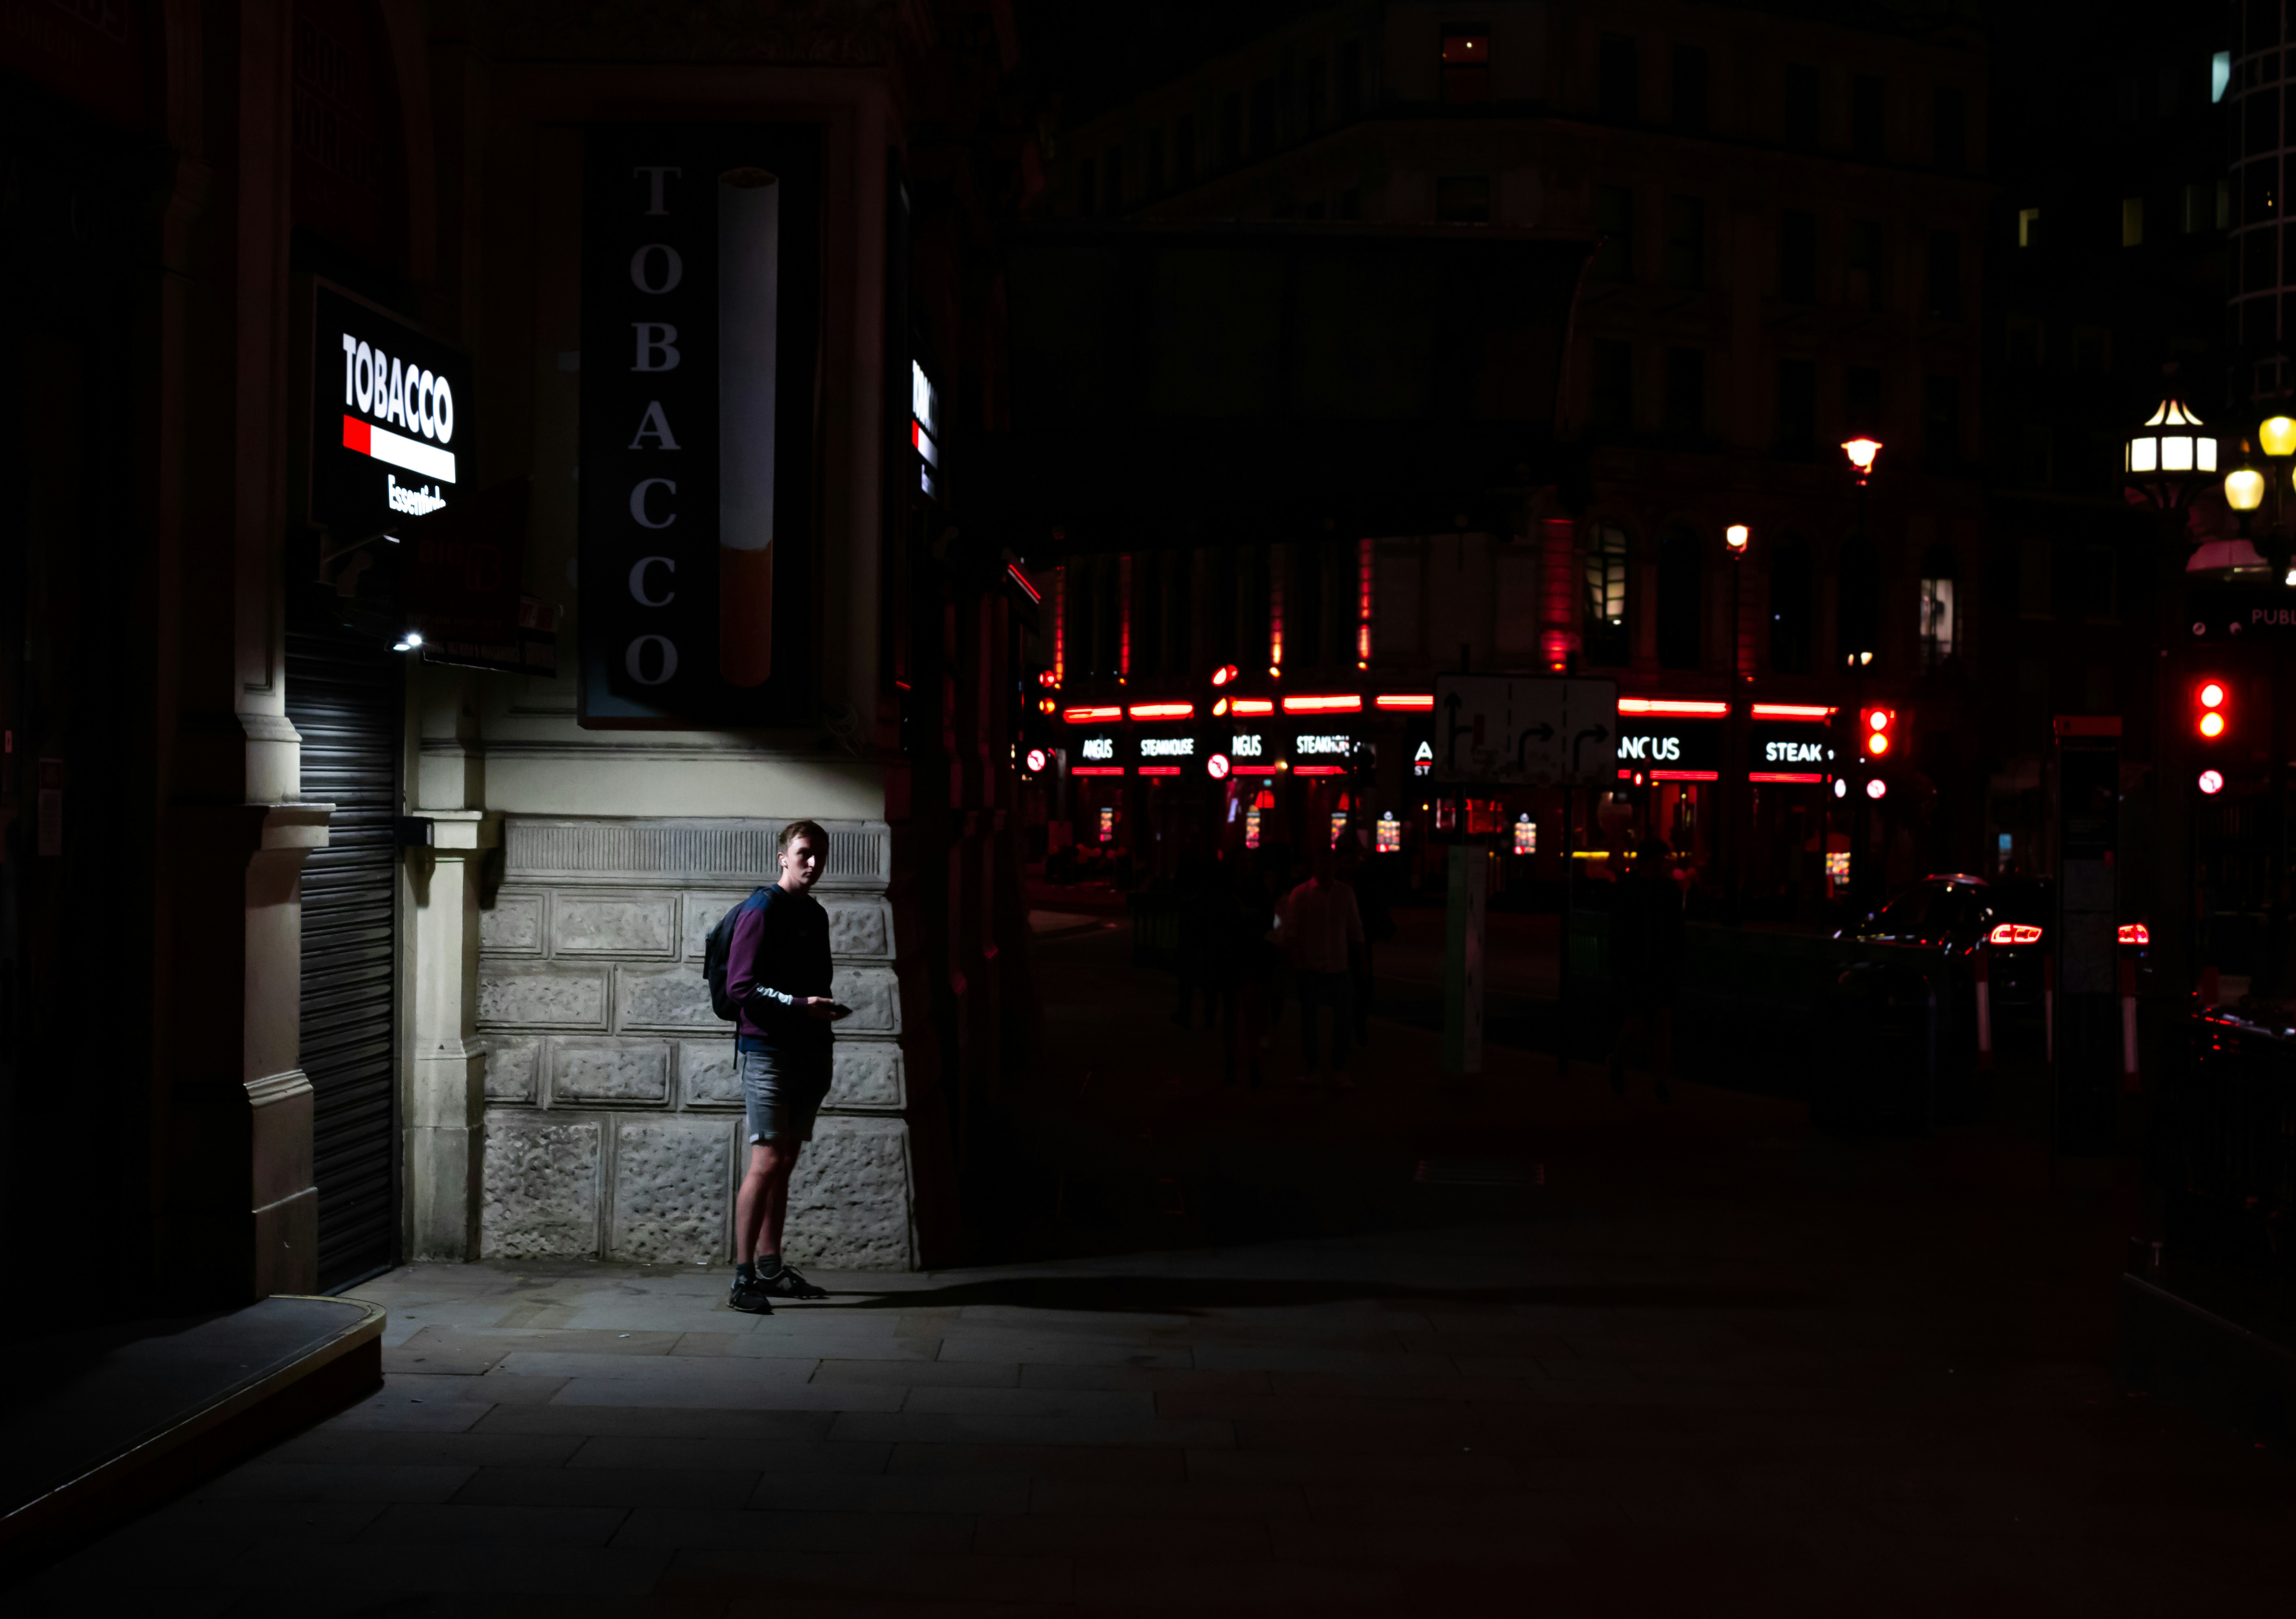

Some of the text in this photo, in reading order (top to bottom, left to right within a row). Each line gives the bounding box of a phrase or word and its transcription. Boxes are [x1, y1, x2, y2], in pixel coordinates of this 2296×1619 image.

[343, 332, 454, 444] TOBACCO
[624, 165, 683, 687] TOBACCO
[1082, 738, 1194, 759] ANGUS STEAKHOUSE
[1231, 734, 1262, 756] NGUS
[1617, 736, 1681, 761] NGUS
[1766, 741, 1835, 762] STEAK
